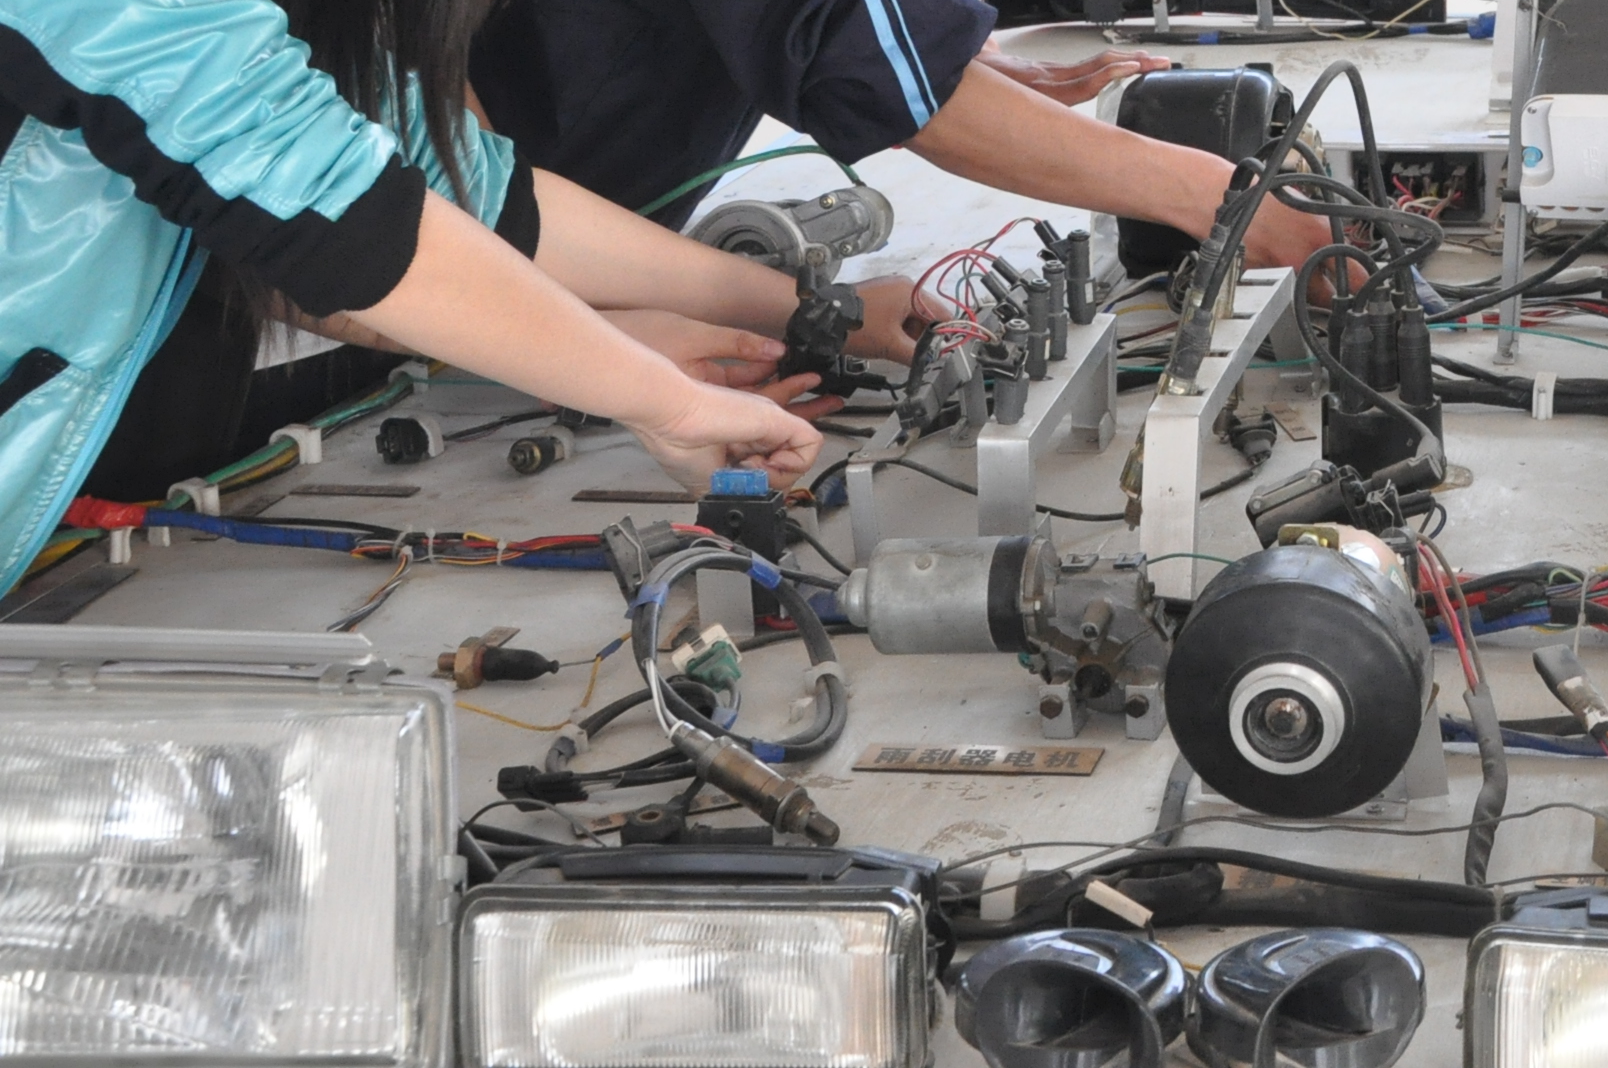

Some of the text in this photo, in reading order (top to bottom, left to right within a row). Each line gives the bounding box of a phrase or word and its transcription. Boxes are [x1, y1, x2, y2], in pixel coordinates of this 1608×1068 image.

[872, 744, 1082, 769] 雨刮器电机
